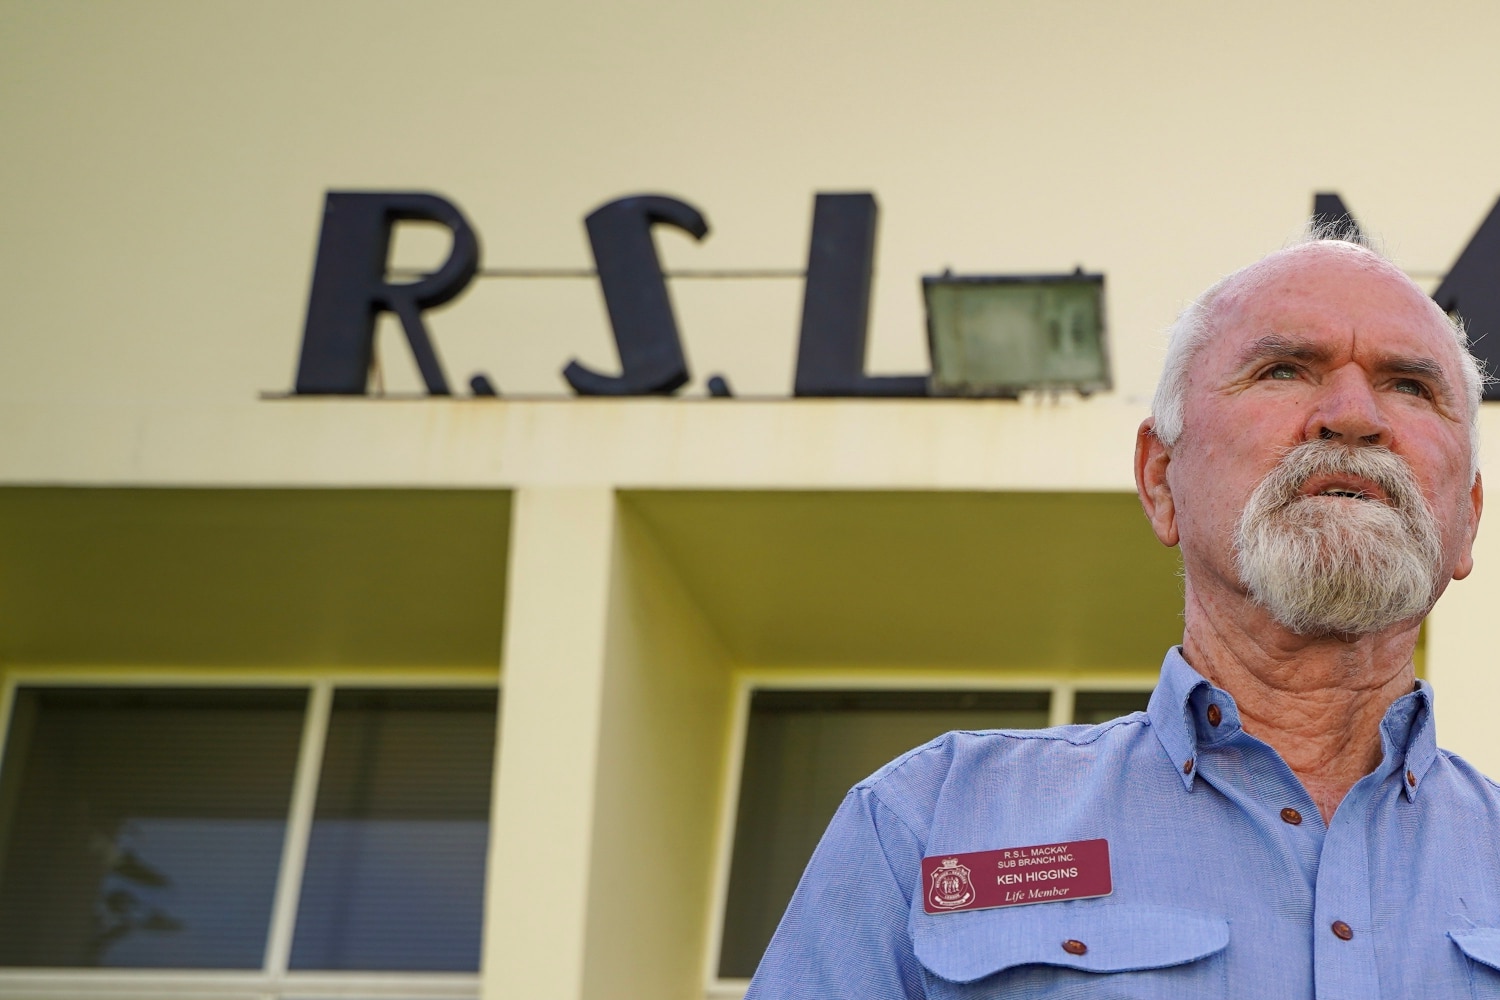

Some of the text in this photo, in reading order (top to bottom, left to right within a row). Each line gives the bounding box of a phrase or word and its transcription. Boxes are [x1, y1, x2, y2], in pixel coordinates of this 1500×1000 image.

[1031, 846, 1068, 856] MACKAY
[997, 854, 1076, 869] SUB BRANCH INC.
[997, 867, 1078, 885] KEN HIGGINS
[1005, 887, 1070, 903] Life Member
